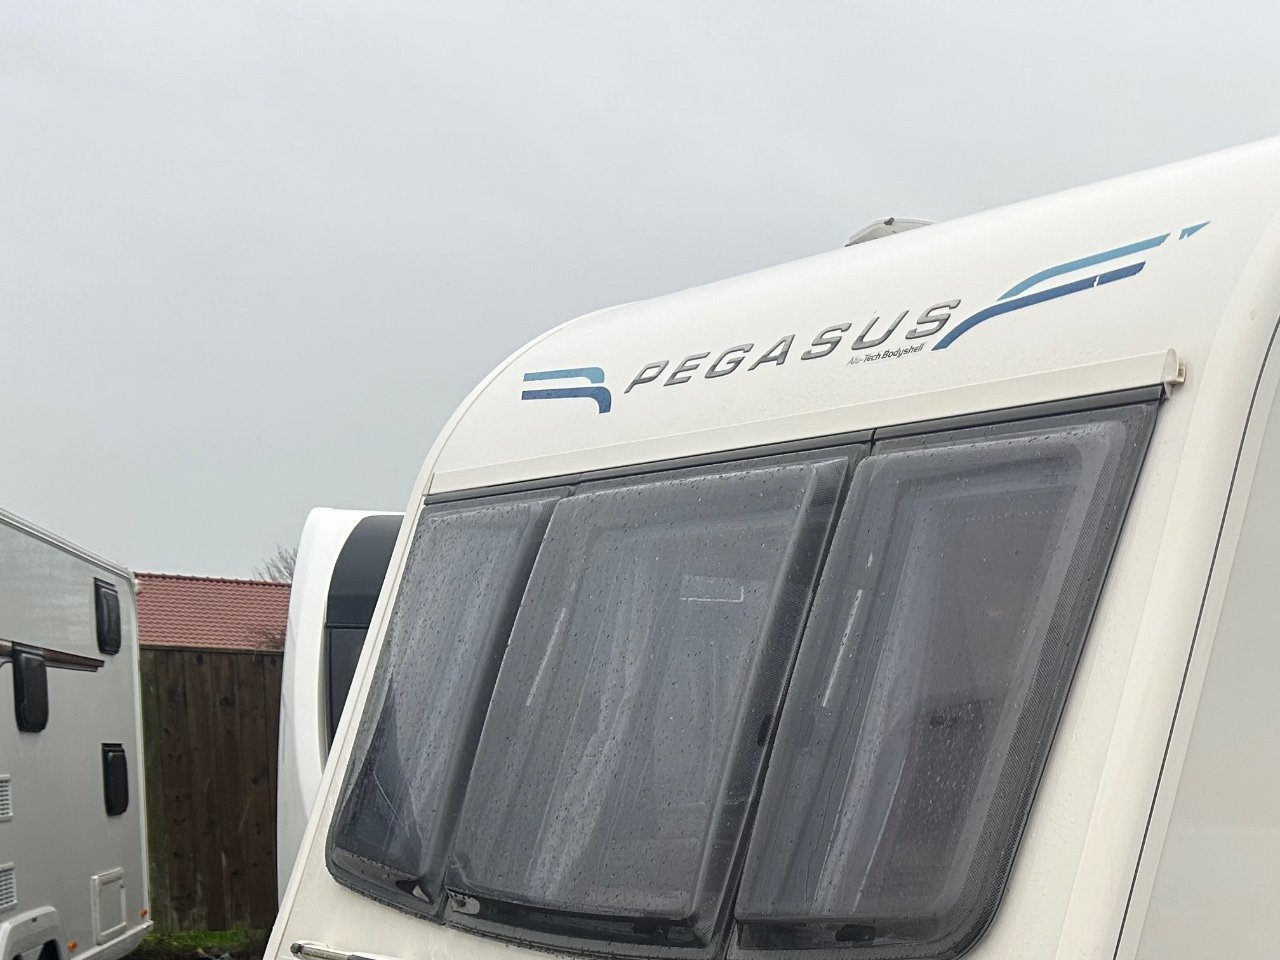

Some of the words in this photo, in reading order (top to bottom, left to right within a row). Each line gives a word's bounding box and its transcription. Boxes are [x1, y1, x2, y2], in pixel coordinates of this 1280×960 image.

[623, 298, 962, 394] PEGASUS
[846, 352, 881, 366] Alu-Tech
[881, 342, 926, 359] Bodyshell
